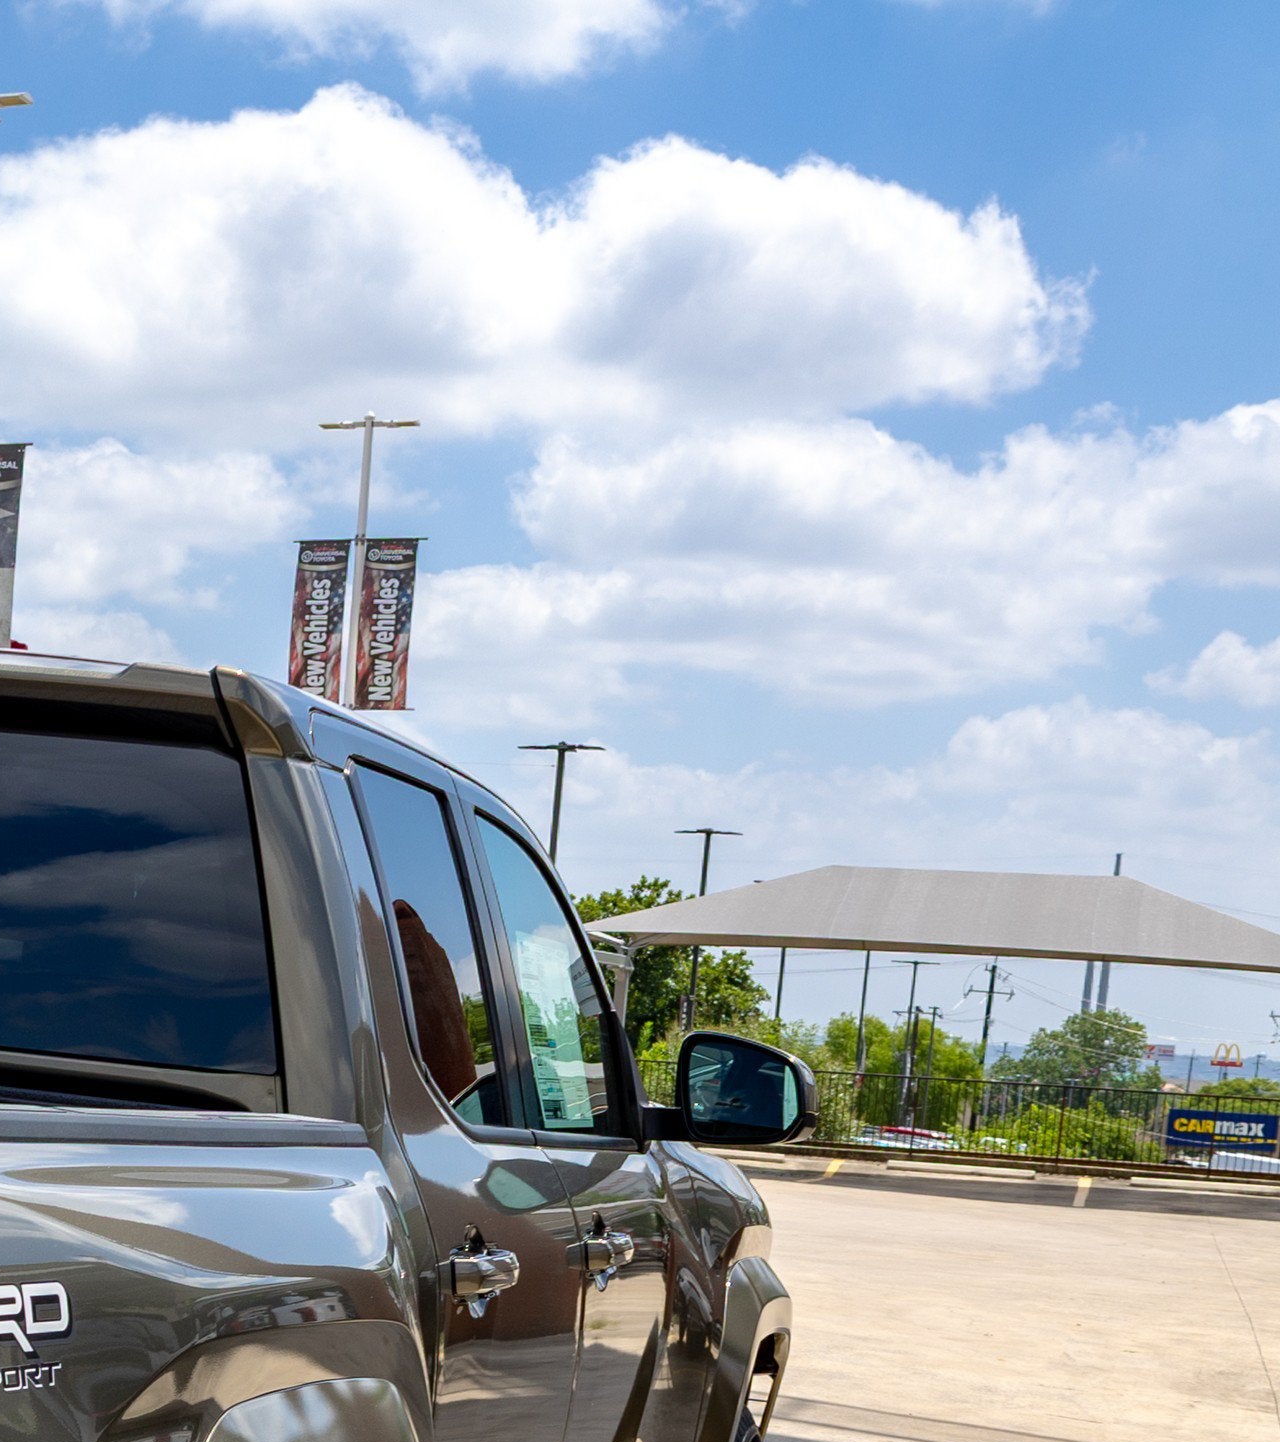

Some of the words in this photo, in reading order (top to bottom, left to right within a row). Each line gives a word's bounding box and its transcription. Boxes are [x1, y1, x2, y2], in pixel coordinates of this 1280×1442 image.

[303, 579, 331, 656] Vehicles
[371, 578, 400, 655] Vehicles
[368, 660, 392, 701] New
